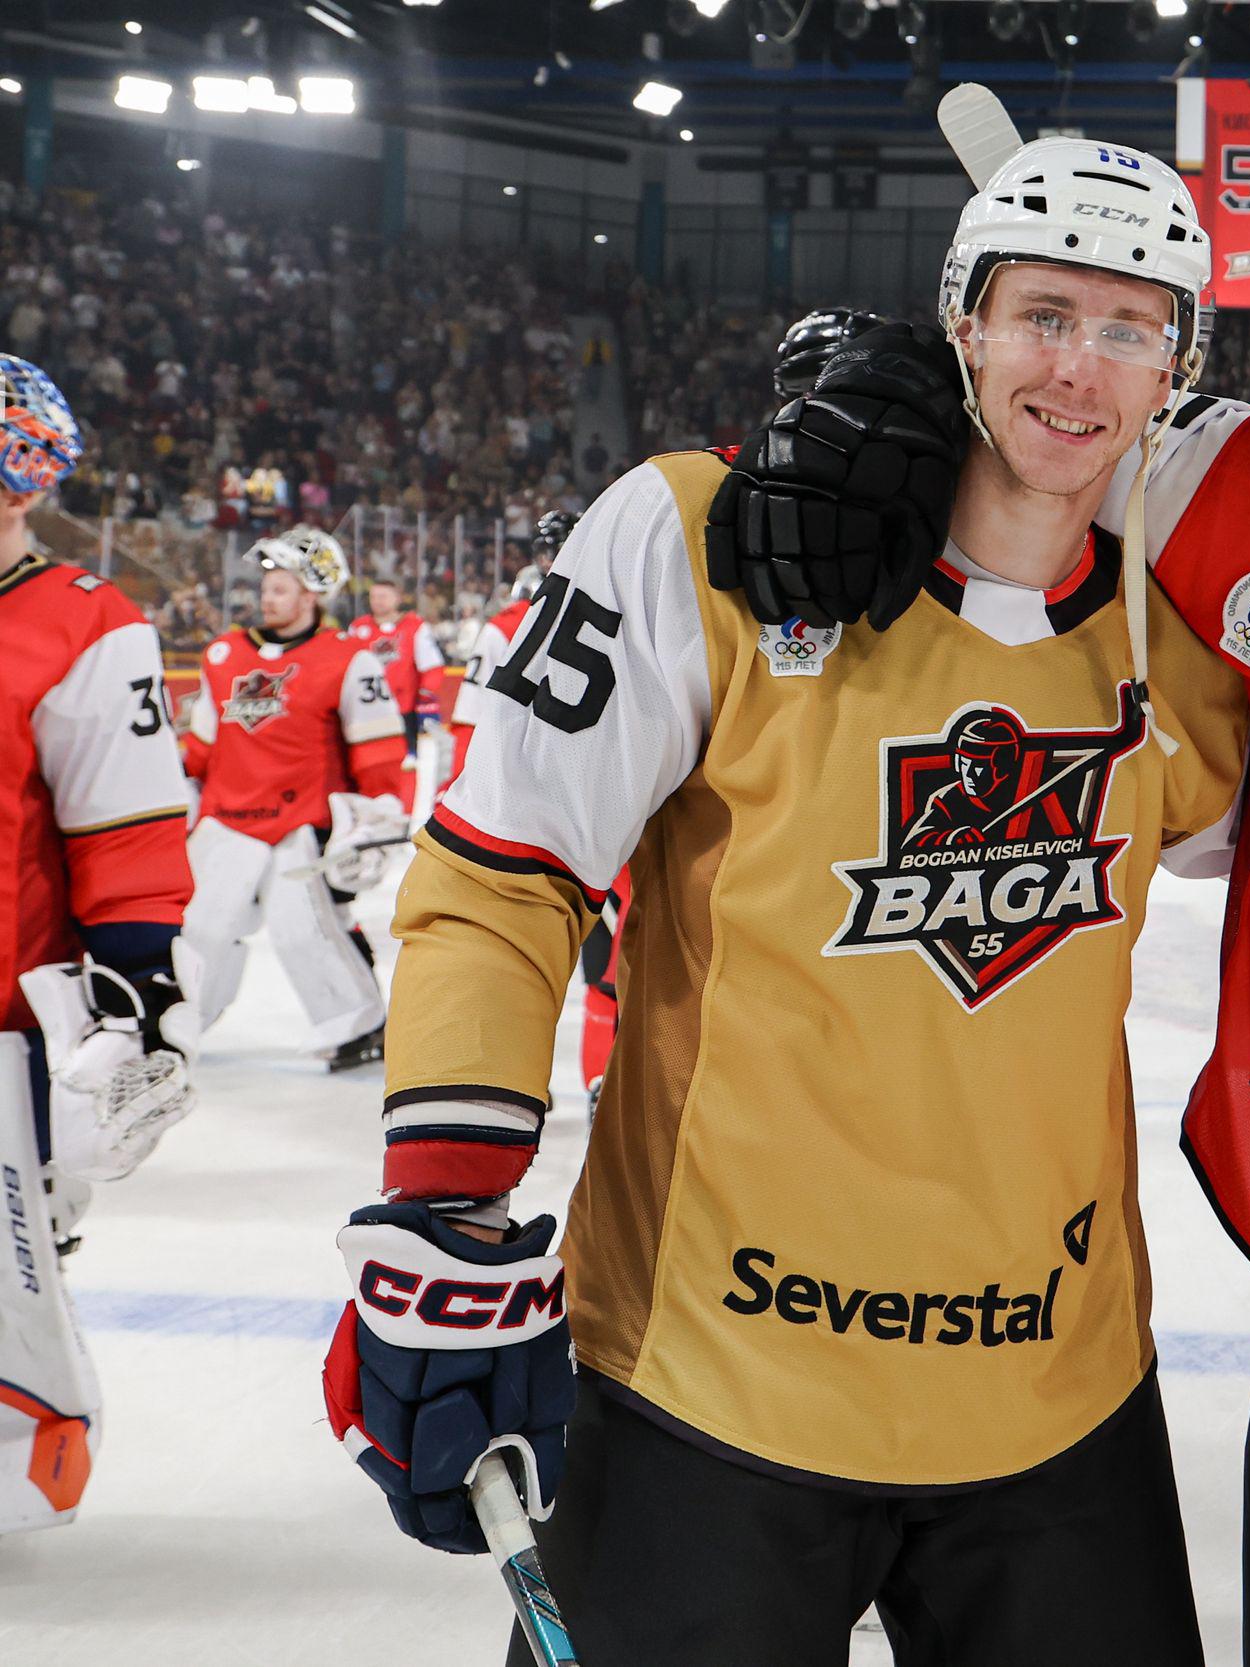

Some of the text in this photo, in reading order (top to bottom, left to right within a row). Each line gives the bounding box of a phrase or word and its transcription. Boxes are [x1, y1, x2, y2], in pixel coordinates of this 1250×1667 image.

[1073, 202, 1151, 228] CCM
[485, 571, 624, 735] 15
[775, 660, 817, 671] 115 ЛЕТ
[1225, 637, 1239, 650] 115
[130, 676, 173, 737] 3
[900, 838, 1082, 869] BOGDAN KISELEVICH
[864, 857, 1099, 937] BAGA
[967, 932, 1005, 958] 55
[3, 1164, 41, 1295] BAUER
[359, 1259, 566, 1330] CCM
[722, 1247, 1064, 1348] Severstal
